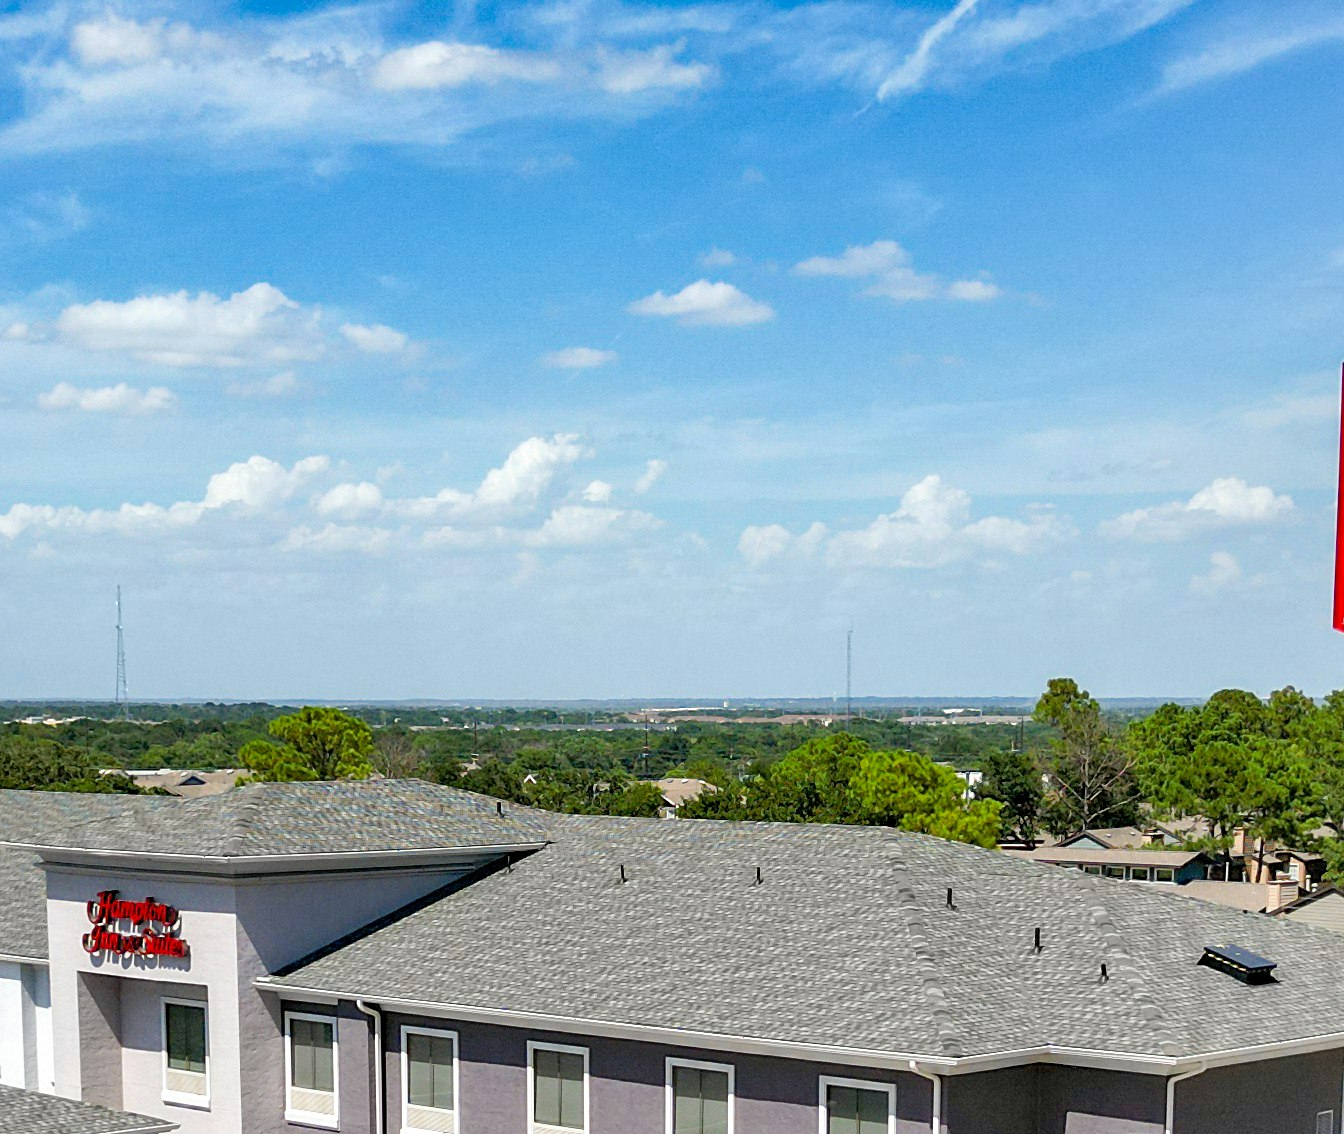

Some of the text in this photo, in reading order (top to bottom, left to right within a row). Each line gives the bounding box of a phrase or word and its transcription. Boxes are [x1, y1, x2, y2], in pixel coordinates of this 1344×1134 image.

[87, 890, 179, 927] Hampton
[82, 925, 128, 954] Inn
[139, 928, 186, 957] Suites
